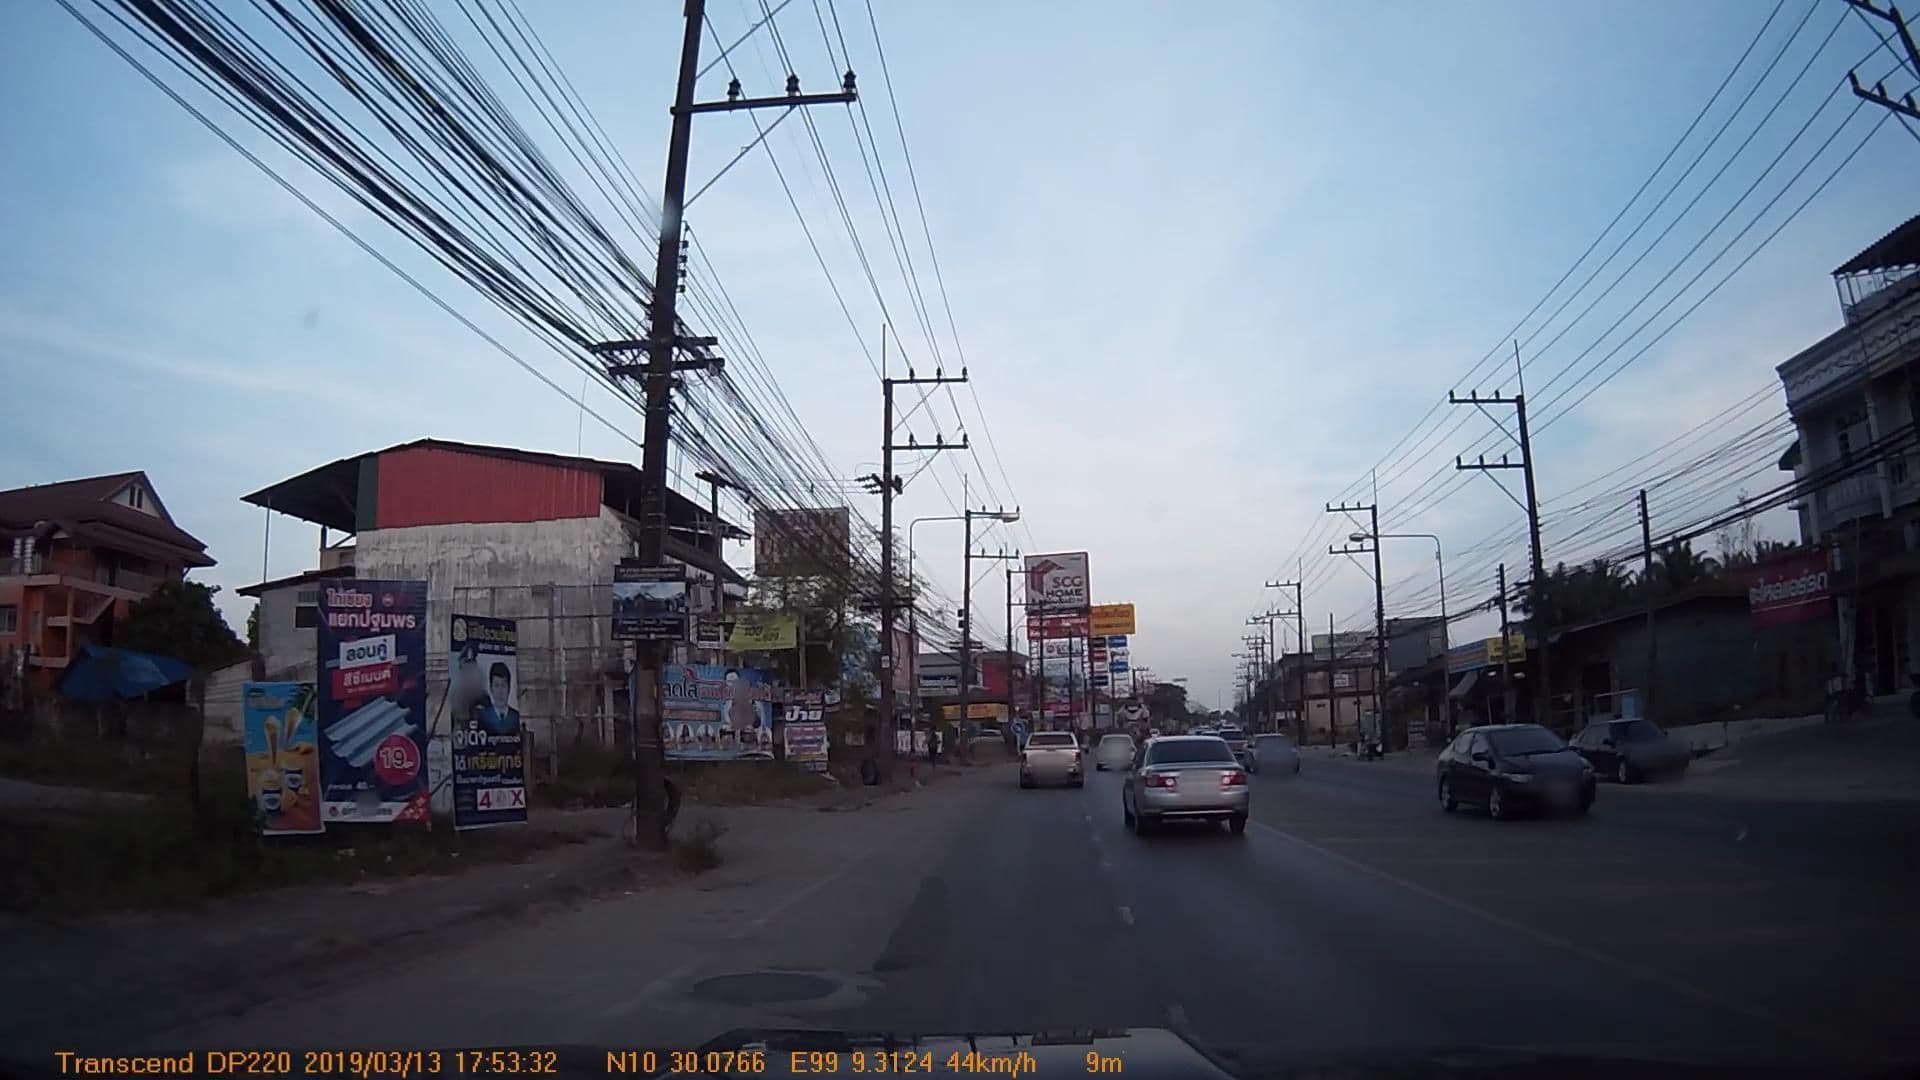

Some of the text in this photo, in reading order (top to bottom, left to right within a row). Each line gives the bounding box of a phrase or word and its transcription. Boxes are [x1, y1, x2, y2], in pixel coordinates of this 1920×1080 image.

[1052, 576, 1083, 588] SCG
[1046, 588, 1083, 598] HOME
[328, 609, 416, 633] แยกปฐมพร
[346, 639, 389, 662] ลอนคู่
[479, 790, 492, 808] 4
